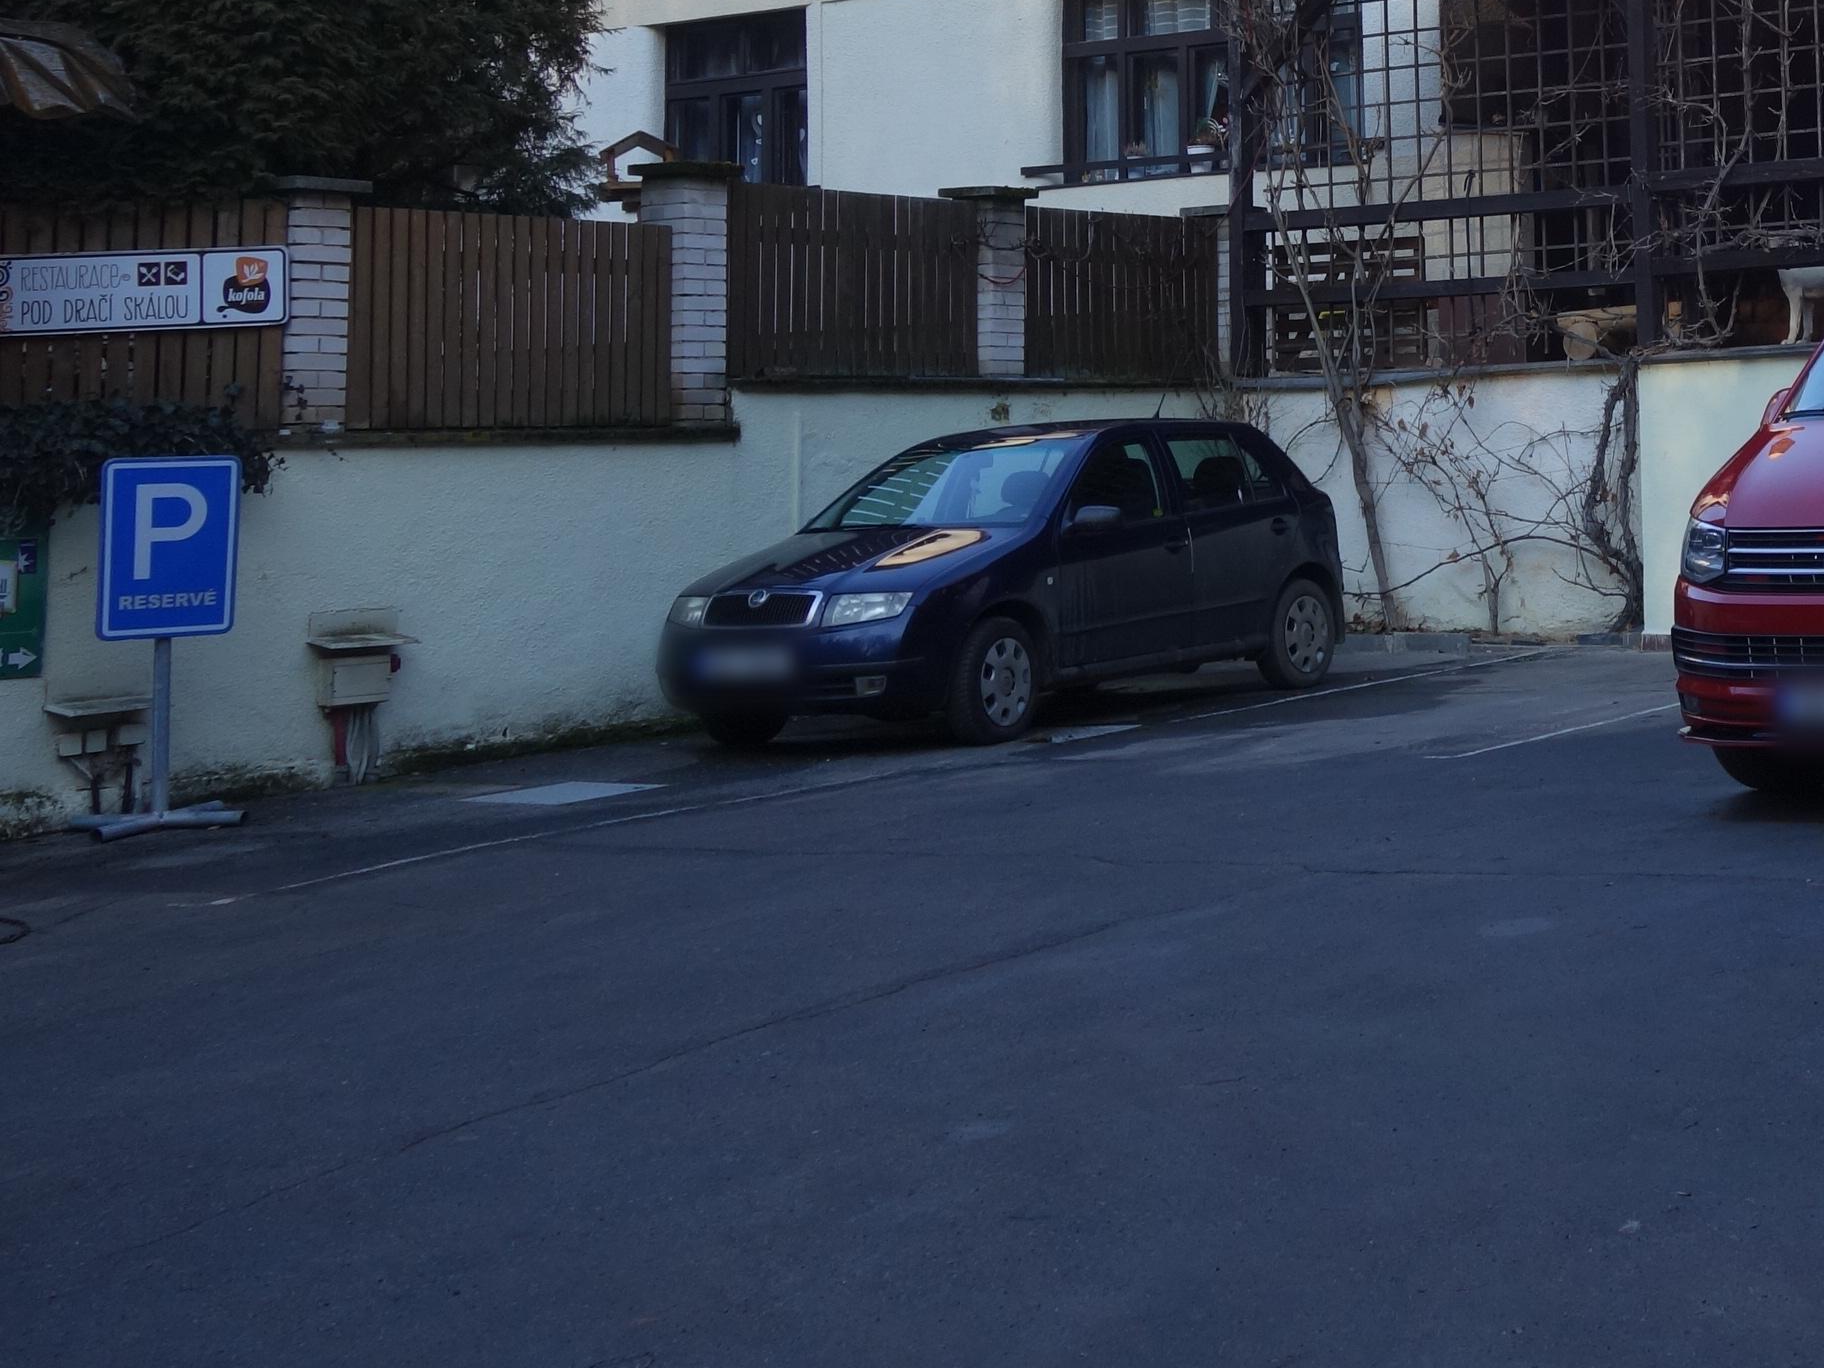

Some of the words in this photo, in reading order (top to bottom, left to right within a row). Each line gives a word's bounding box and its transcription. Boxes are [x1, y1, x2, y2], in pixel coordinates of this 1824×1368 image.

[21, 300, 53, 325] POD
[63, 293, 113, 322] DRAČÍ
[124, 292, 189, 321] SKÁLOU
[227, 287, 265, 305] kofola
[133, 483, 208, 580] P
[118, 589, 218, 610] RESERVÉ
